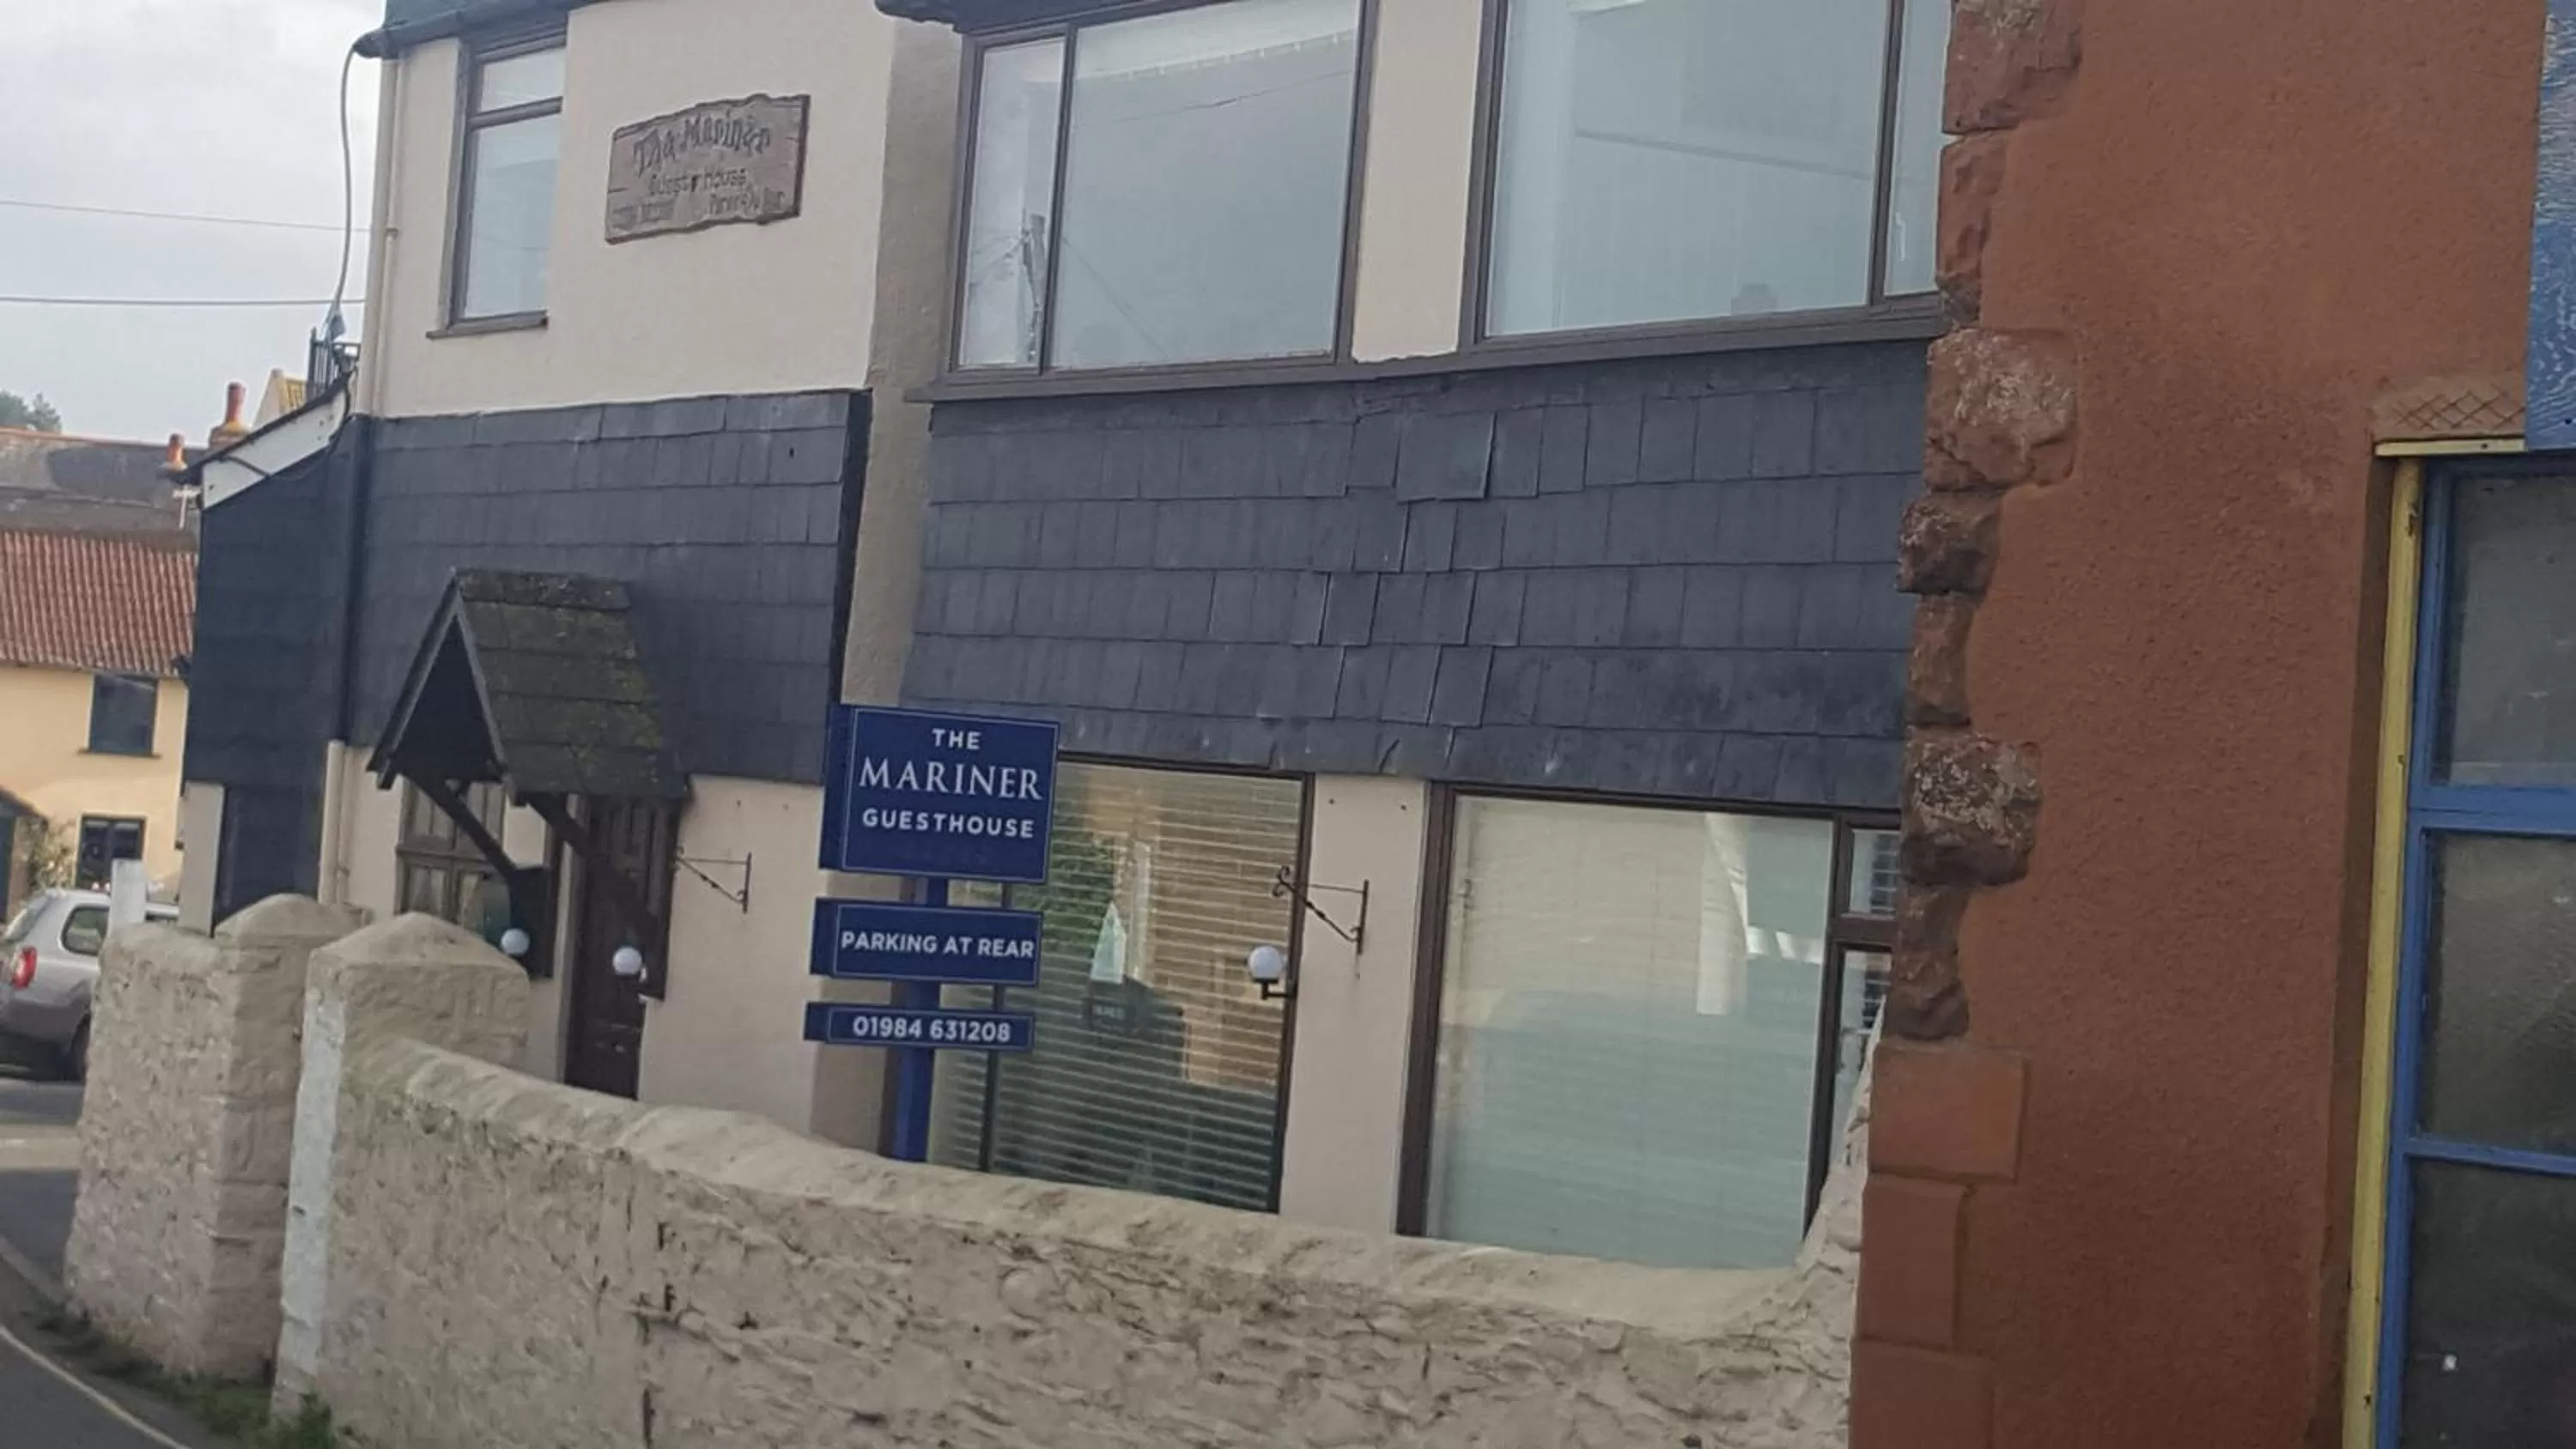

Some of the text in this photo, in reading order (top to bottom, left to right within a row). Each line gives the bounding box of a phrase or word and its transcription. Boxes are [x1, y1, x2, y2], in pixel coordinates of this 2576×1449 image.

[932, 728, 981, 750] THE
[859, 756, 1043, 800] MARINER
[862, 808, 1035, 839] GUESTHOUSE
[840, 930, 1036, 959] PARKING AT REAR
[853, 1016, 1012, 1043] 01984 631208
